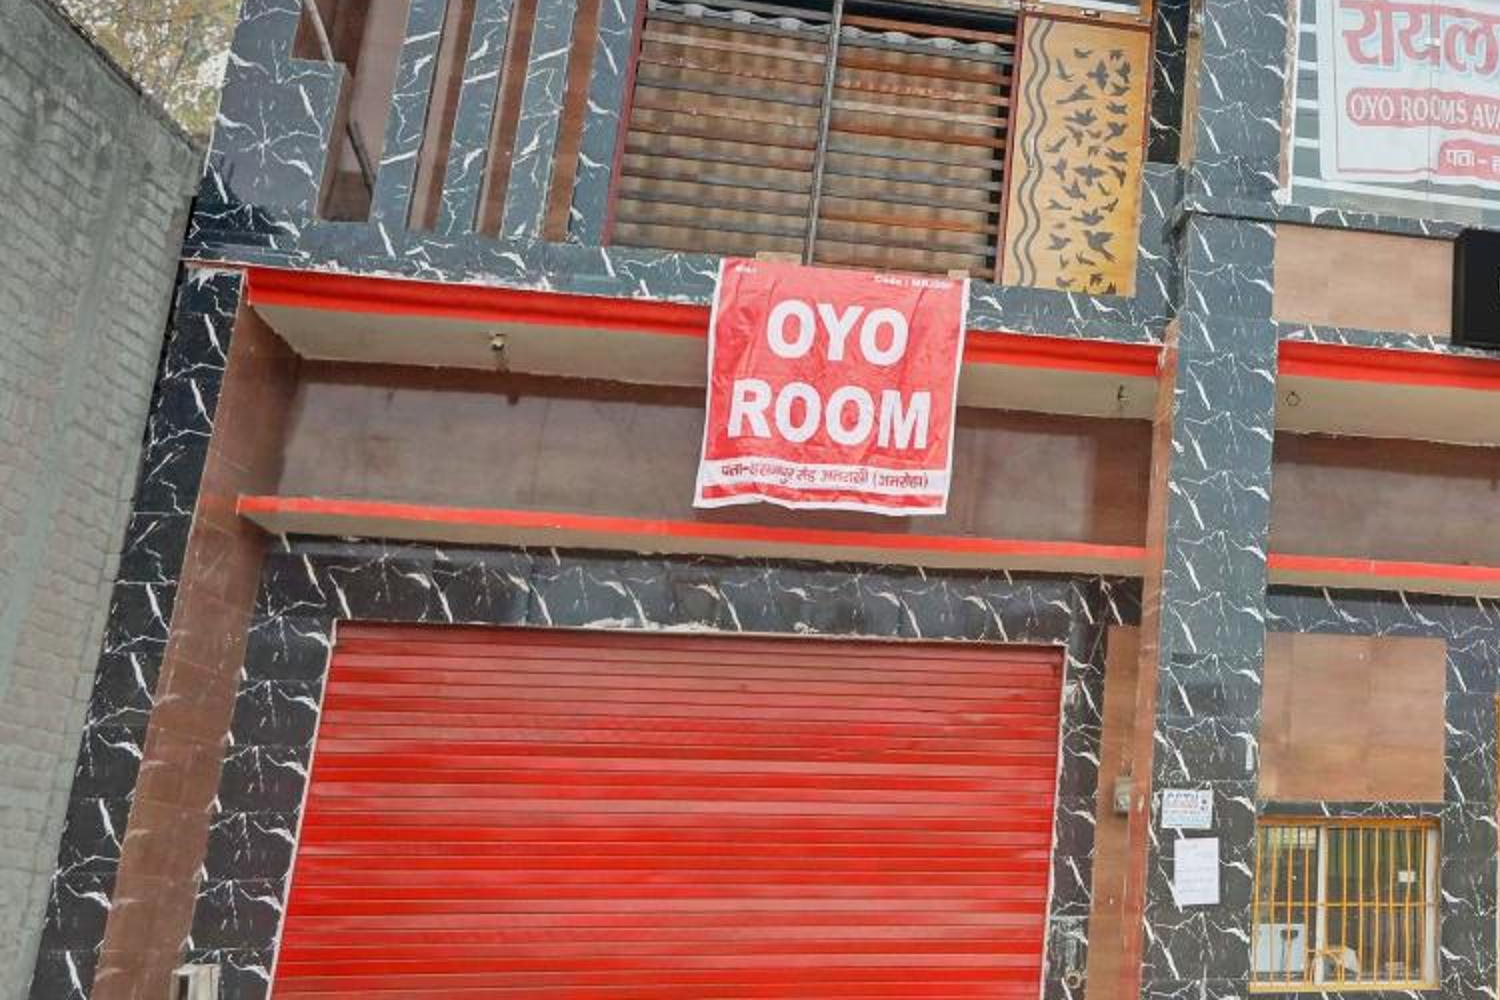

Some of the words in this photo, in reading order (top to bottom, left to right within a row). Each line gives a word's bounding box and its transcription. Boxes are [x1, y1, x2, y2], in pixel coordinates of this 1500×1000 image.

[1350, 92, 1394, 121] OYO
[1401, 96, 1467, 126] ROOMS
[766, 300, 909, 366] OYO
[727, 378, 931, 449] ROOM
